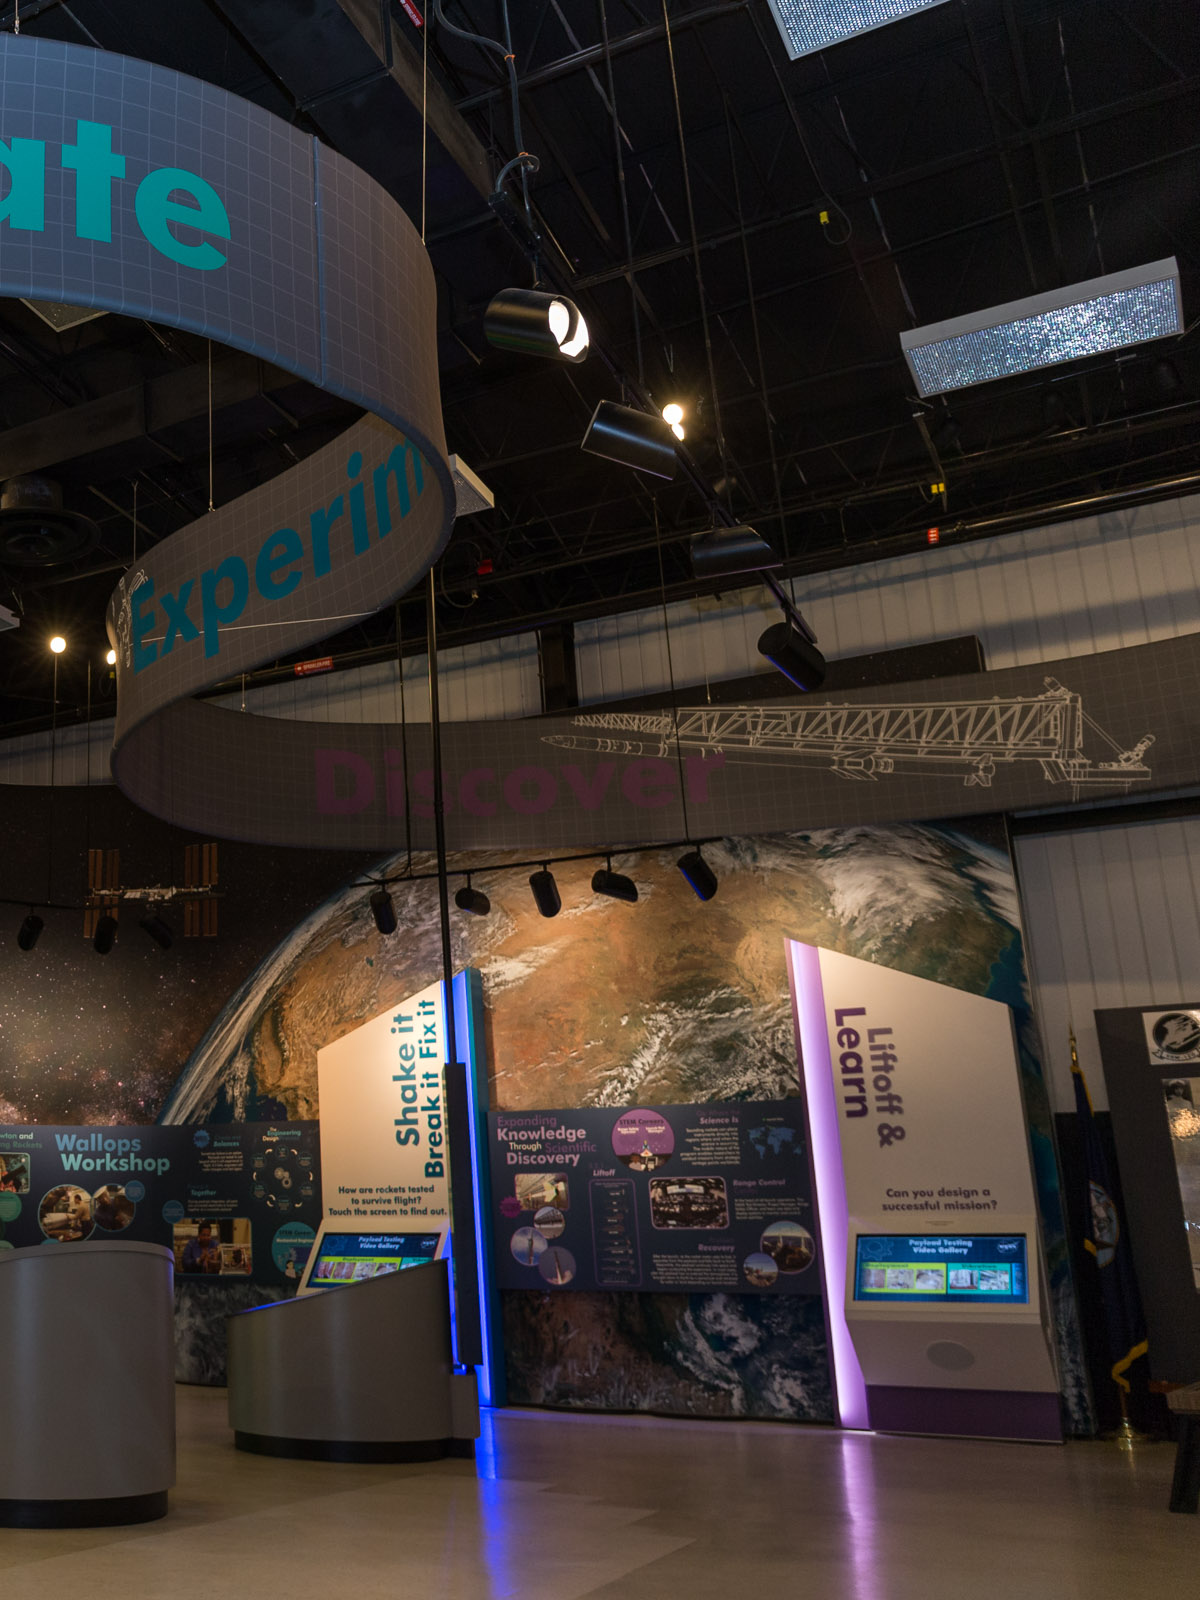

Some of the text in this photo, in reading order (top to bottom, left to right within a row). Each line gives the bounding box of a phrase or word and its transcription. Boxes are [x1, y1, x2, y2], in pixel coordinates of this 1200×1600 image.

[130, 437, 430, 675] Experim
[315, 748, 726, 818] Discover
[834, 1007, 868, 1118] Learn
[391, 1013, 420, 1147] Shake it
[417, 1000, 444, 1178] Break it Fix it
[867, 1027, 906, 1148] Liftoff &
[497, 1115, 557, 1127] Expanding
[19, 1132, 34, 1140] and
[497, 1126, 586, 1142] Knowledge
[55, 1133, 141, 1156] Wallops
[509, 1141, 597, 1153] Through Scientific
[61, 1153, 170, 1176] Workshop
[507, 1153, 580, 1167] Discovery
[593, 1169, 616, 1177] Liftoff
[338, 1186, 356, 1194] How
[376, 1185, 405, 1193] rockets
[408, 1185, 434, 1193] tested
[886, 1188, 909, 1197] Can
[912, 1189, 934, 1199] you
[937, 1187, 978, 1199] design
[394, 1196, 421, 1206] flight?
[882, 1200, 997, 1211] successful mission?
[329, 1208, 352, 1216] Touch
[411, 1207, 427, 1215] find
[909, 1239, 972, 1248] Payload Testing
[913, 1246, 968, 1255] Video Gallery
